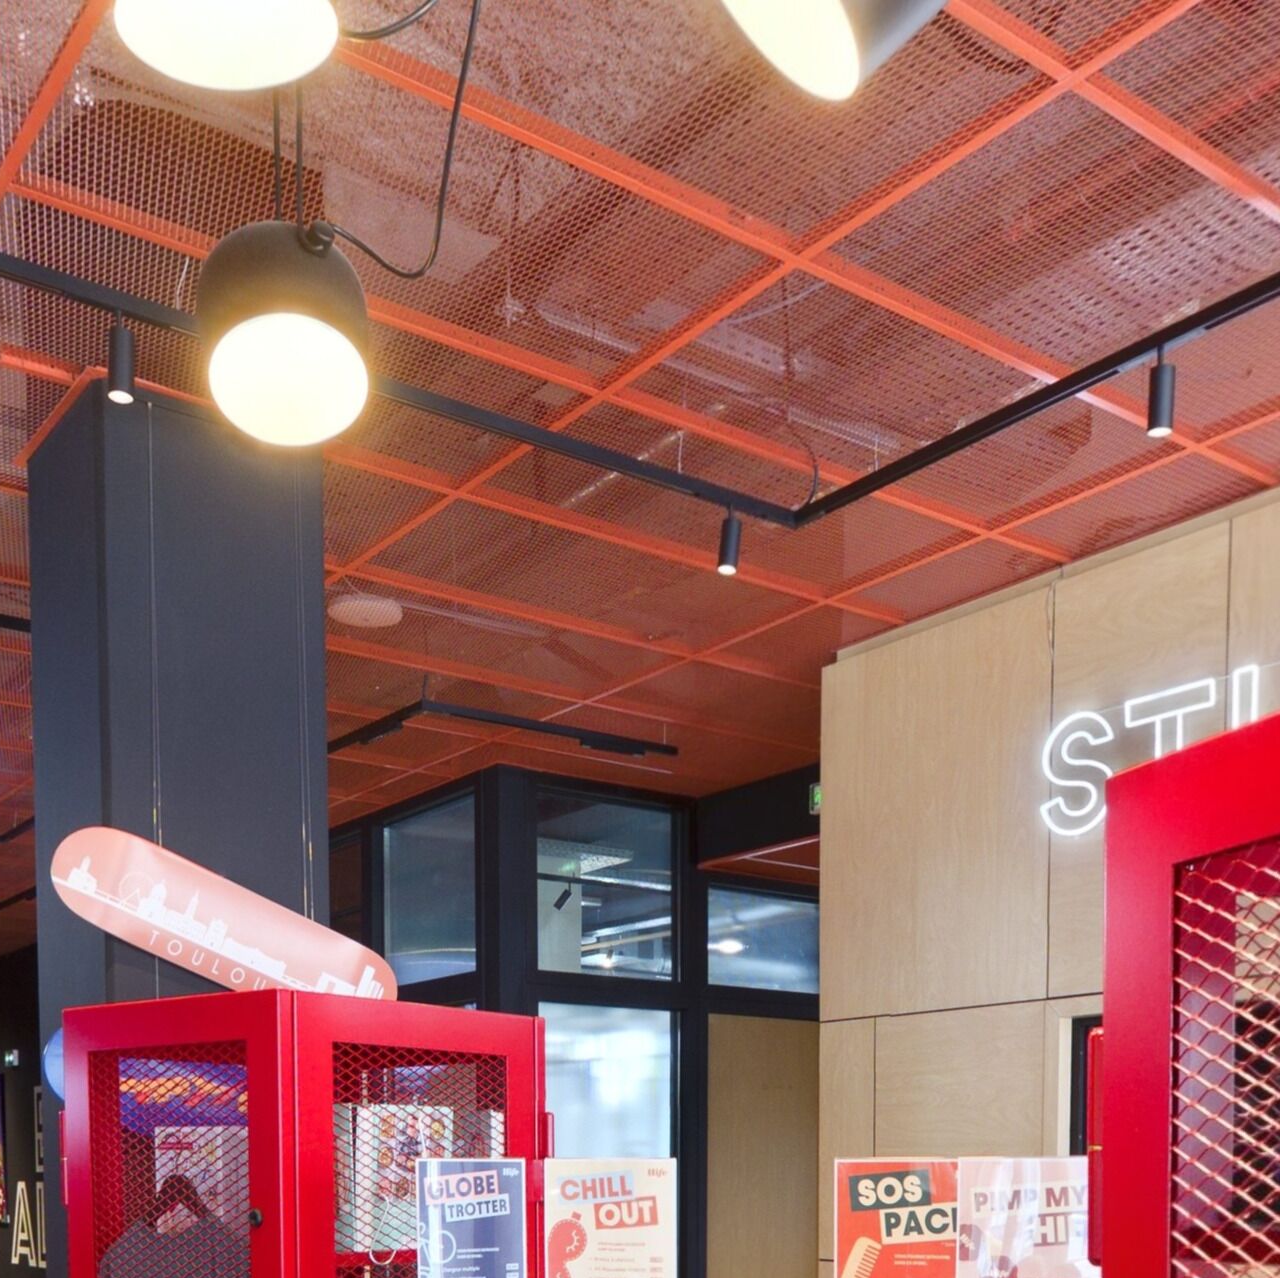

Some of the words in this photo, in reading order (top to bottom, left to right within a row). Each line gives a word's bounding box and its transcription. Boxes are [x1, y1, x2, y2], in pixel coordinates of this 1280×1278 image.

[426, 1173, 497, 1201] GLOBE
[560, 1174, 633, 1201] CHILL
[856, 1173, 924, 1207] SOS
[447, 1198, 509, 1219] TROTTER
[598, 1200, 654, 1227] OUT
